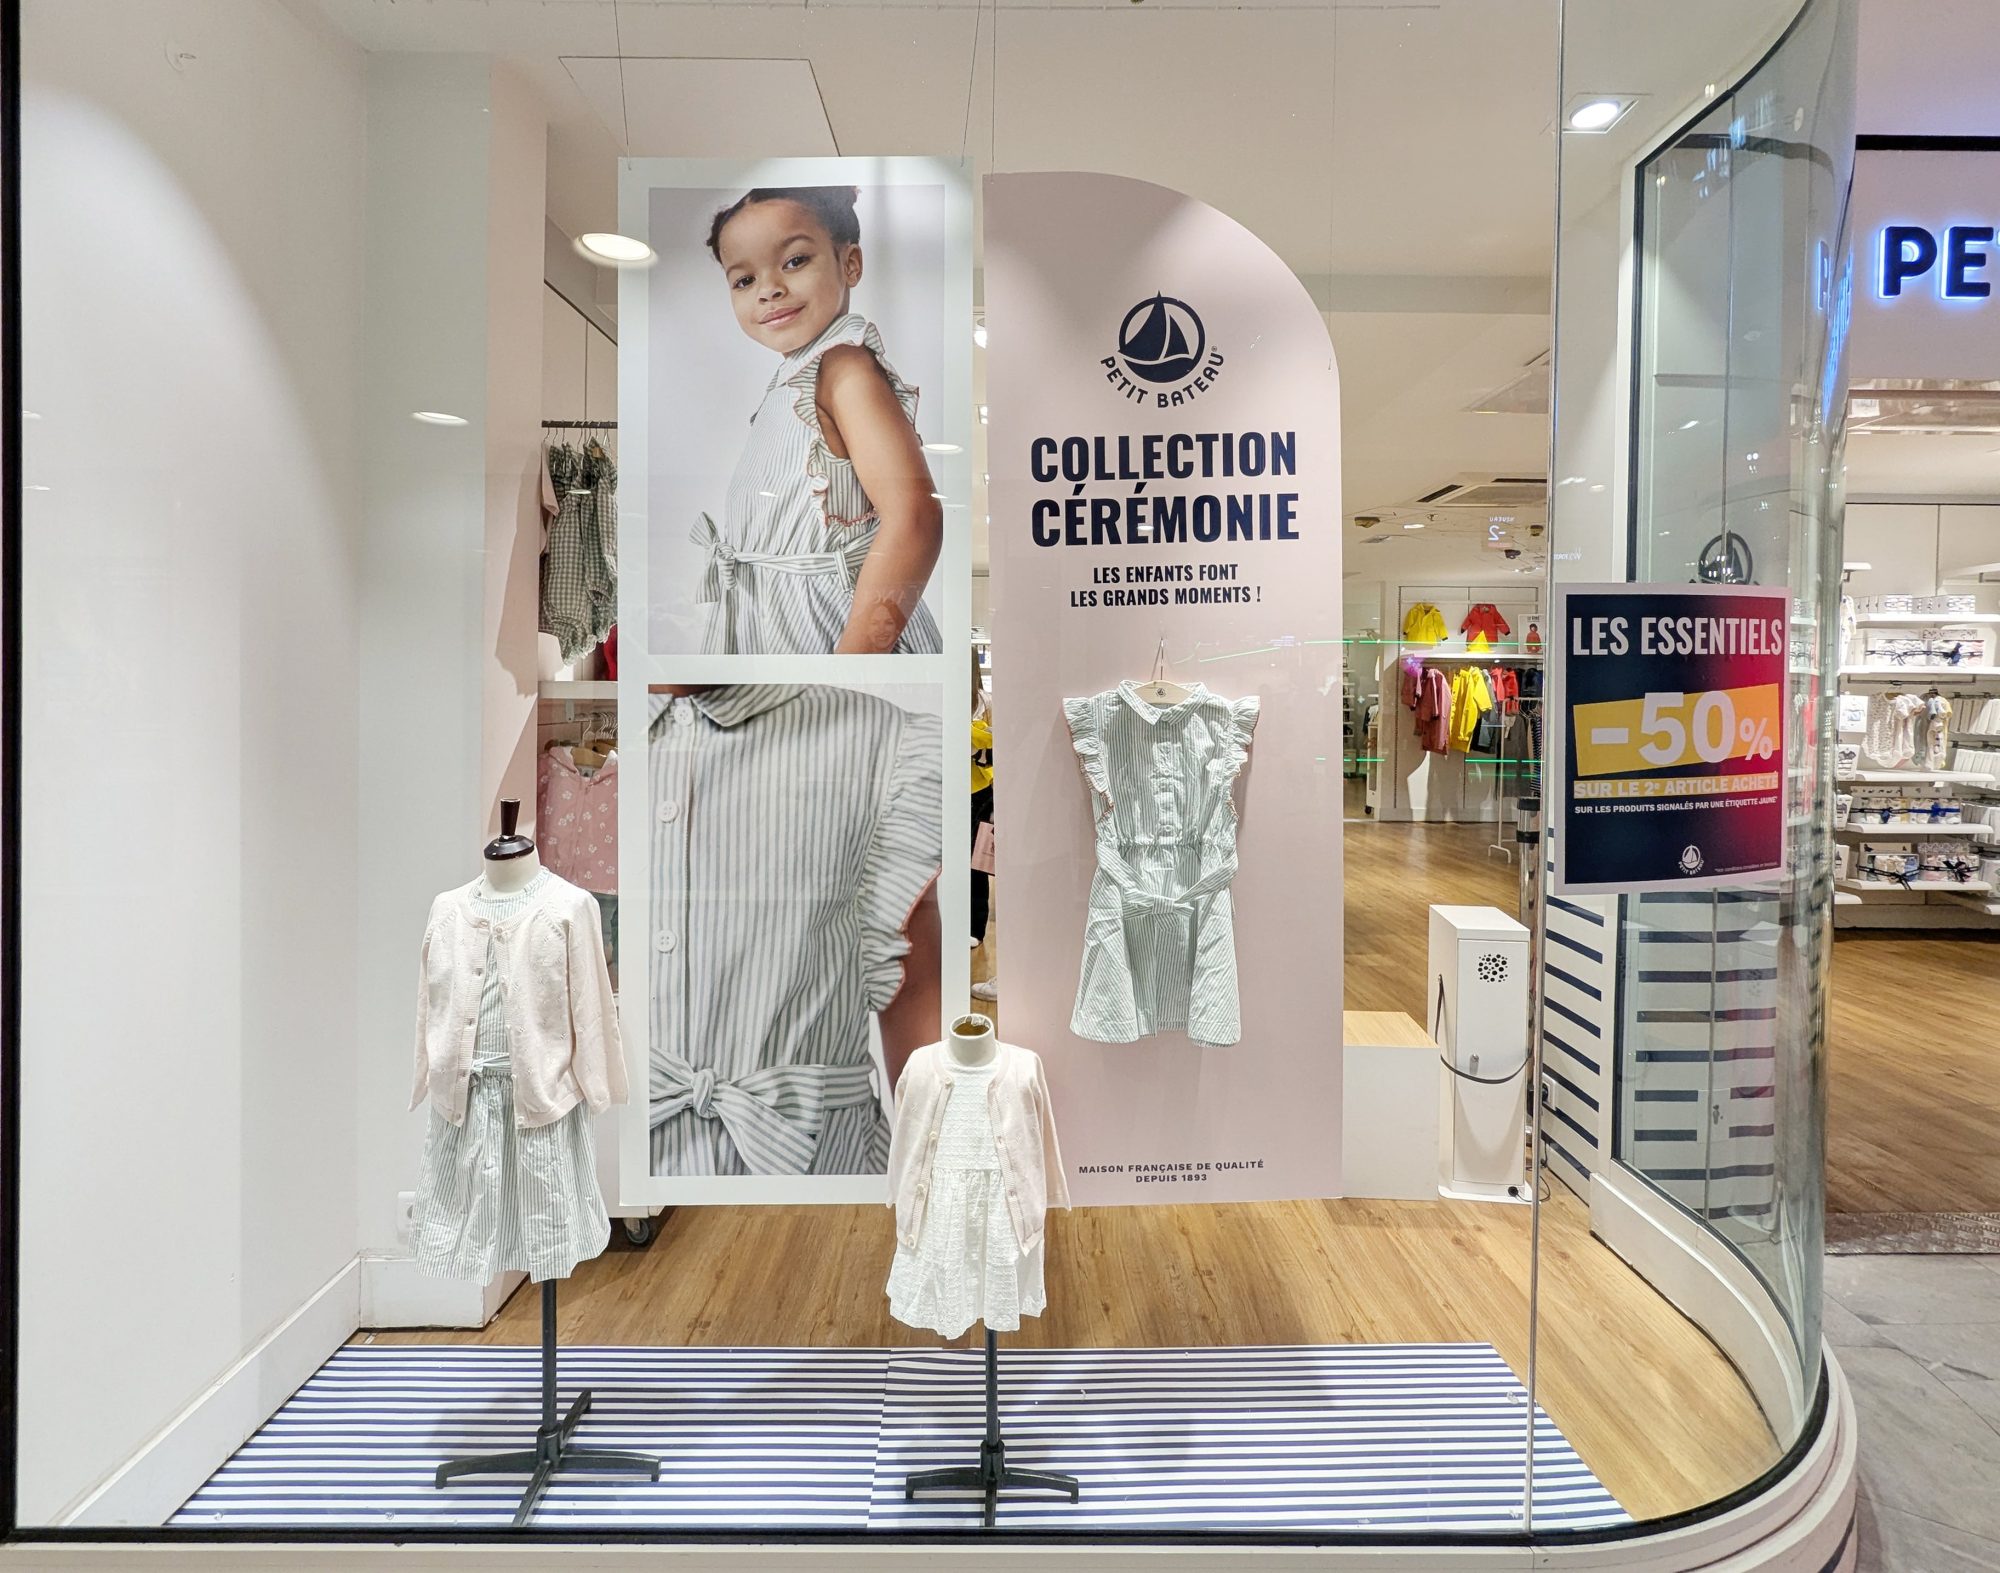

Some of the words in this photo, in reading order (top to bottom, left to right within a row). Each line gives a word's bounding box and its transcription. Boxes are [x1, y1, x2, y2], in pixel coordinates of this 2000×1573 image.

[1879, 225, 2000, 299] PE
[1100, 355, 1149, 404] PETIT
[1157, 353, 1225, 408] BATEAU
[1031, 431, 1297, 483] COLLECTION
[1031, 481, 1300, 548] CÉRÉMONIE
[1093, 567, 1120, 584] LES
[1126, 565, 1194, 583] ENFANTS
[1199, 563, 1239, 581] FONT
[1070, 590, 1098, 608] LES
[1103, 588, 1169, 607] GRANDS
[1174, 586, 1252, 605] MOMENTS
[1255, 586, 1262, 603] !
[1573, 617, 1629, 656] LES
[1641, 616, 1783, 656] ESSENTIELS
[1591, 690, 1773, 766] -50%
[1575, 782, 1612, 798] SUR
[1617, 781, 1640, 797] LE
[1664, 777, 1729, 796] ARTICLE
[1575, 806, 1593, 814] SUR
[1595, 805, 1611, 813] LES
[1613, 804, 1655, 813] PRODUITS
[1656, 801, 1694, 811] SIGNALÉS
[1695, 800, 1709, 809] PAR
[1710, 800, 1724, 808] UNE
[1725, 798, 1758, 808] ÉTIQUETTE
[1079, 1165, 1124, 1174] MAISON
[1128, 1163, 1193, 1173] FRANÇAISE
[1196, 1162, 1212, 1170] DE
[1215, 1158, 1264, 1171] QUALITÉ
[1136, 1174, 1177, 1183] DEPUIS
[1181, 1173, 1207, 1181] 1893
